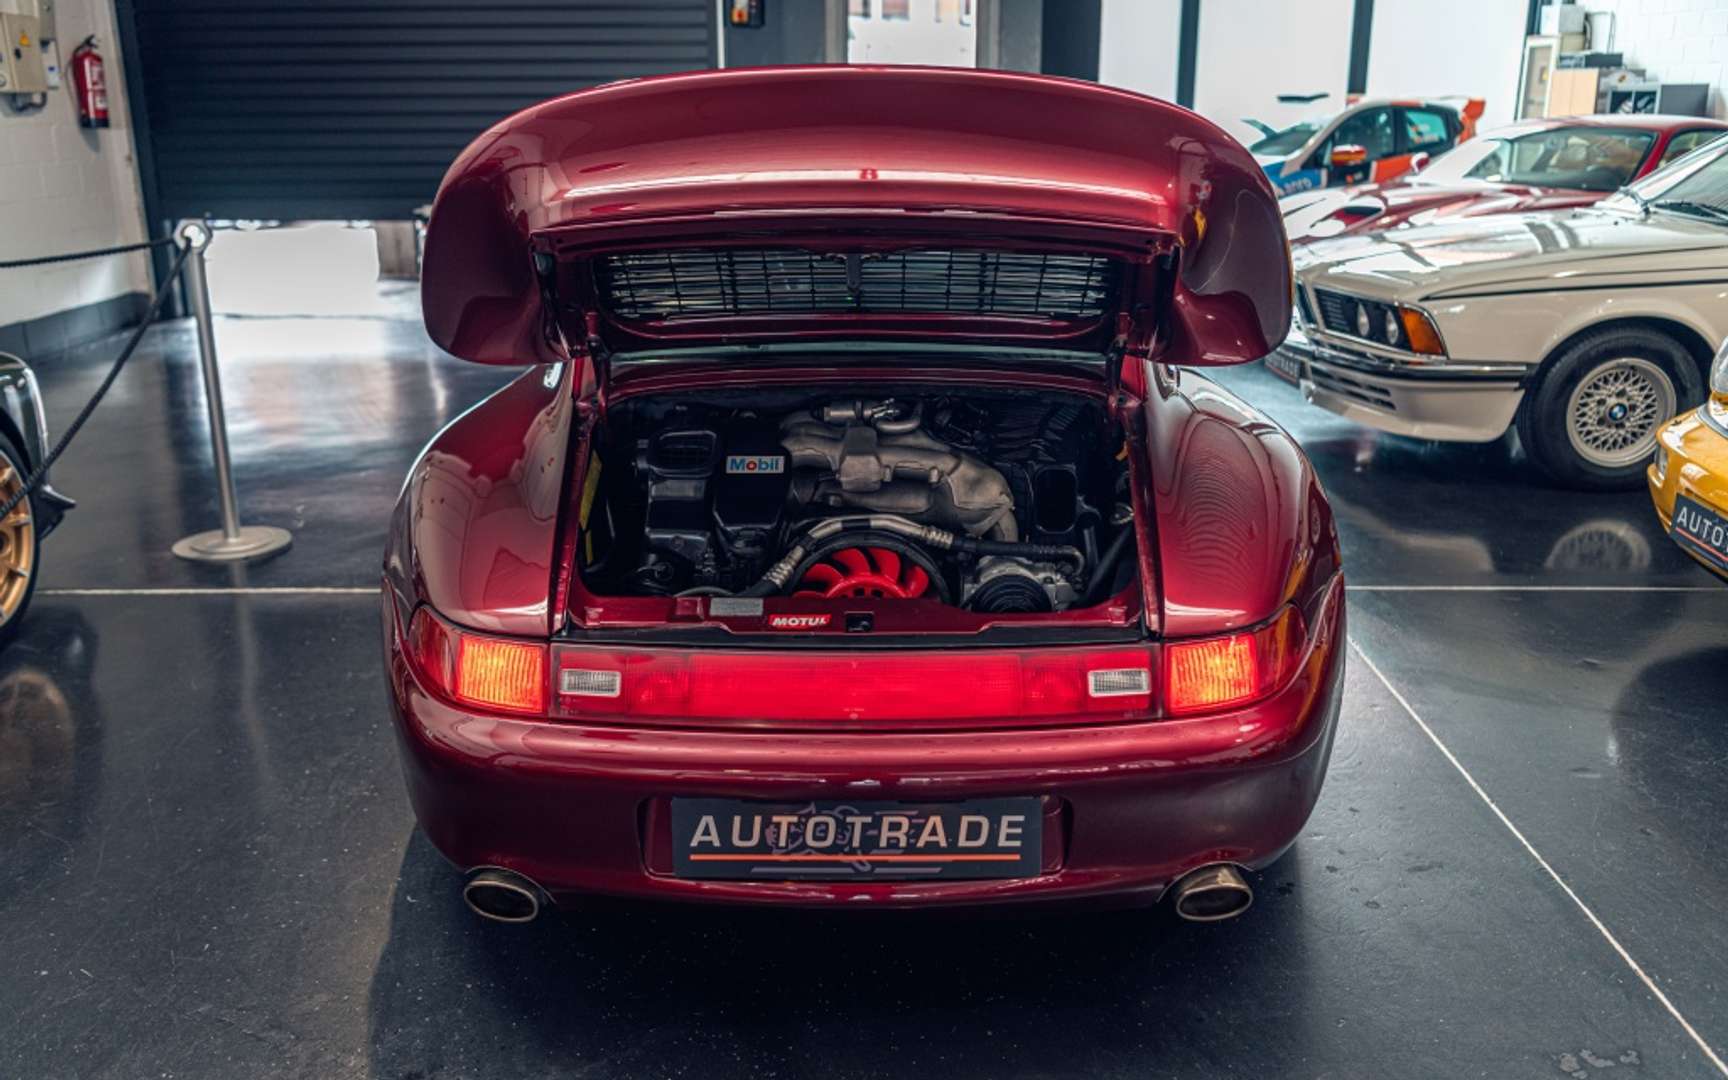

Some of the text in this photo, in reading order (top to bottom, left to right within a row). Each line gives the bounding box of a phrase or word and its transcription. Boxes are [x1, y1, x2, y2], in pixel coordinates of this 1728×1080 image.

[729, 458, 780, 471] Mobil
[772, 617, 828, 626] MOTUL
[690, 815, 1026, 848] AUTOTRADE
